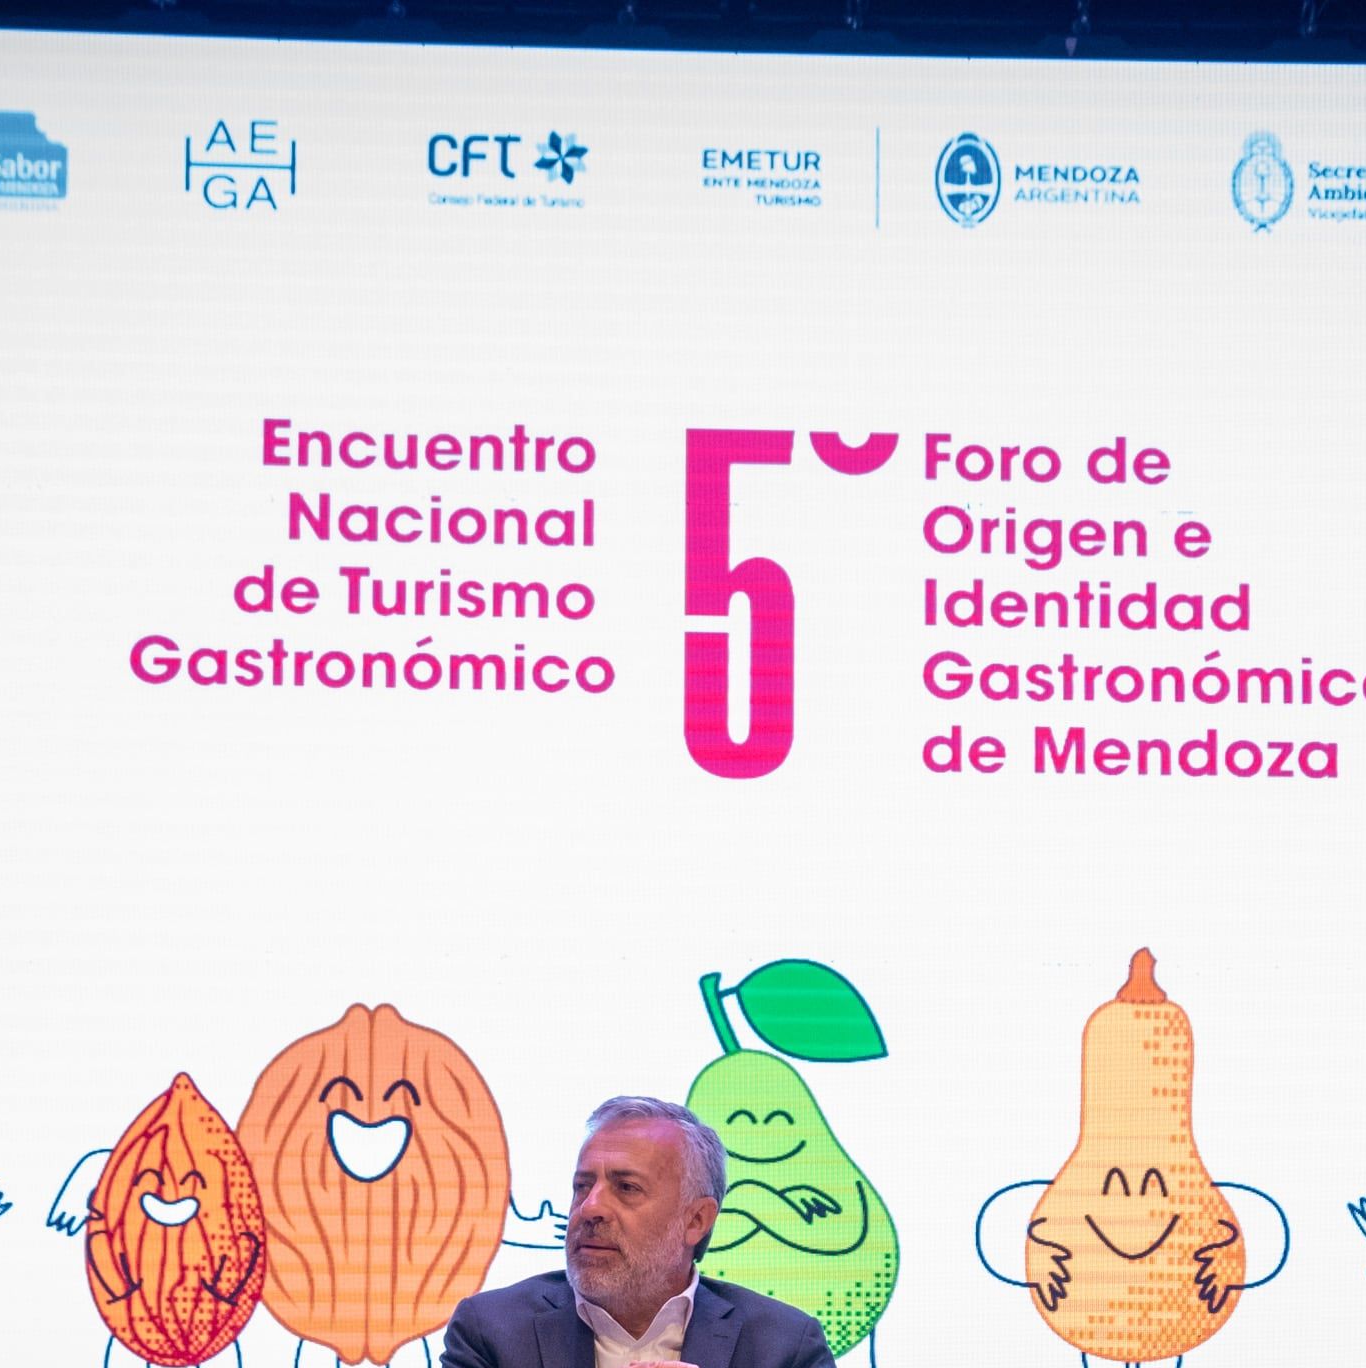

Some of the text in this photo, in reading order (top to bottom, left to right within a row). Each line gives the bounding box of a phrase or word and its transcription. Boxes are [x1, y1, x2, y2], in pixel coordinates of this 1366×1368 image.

[427, 132, 522, 180] CFT
[701, 147, 822, 173] EMETUR
[1014, 164, 1140, 184] MENDOZA
[702, 176, 822, 190] ENTE MENDOZA
[755, 194, 822, 207] TURISMO
[1014, 187, 1141, 205] ARGENTINA
[263, 419, 595, 474] Encuentro
[924, 433, 1171, 485] Foro de
[288, 491, 595, 547] Nacional
[923, 505, 1212, 571] Origen e
[233, 564, 595, 620] de Turismo
[924, 578, 1250, 632] Identidad
[130, 635, 615, 694] Gastronómico
[923, 725, 1338, 778] de Mendoza
